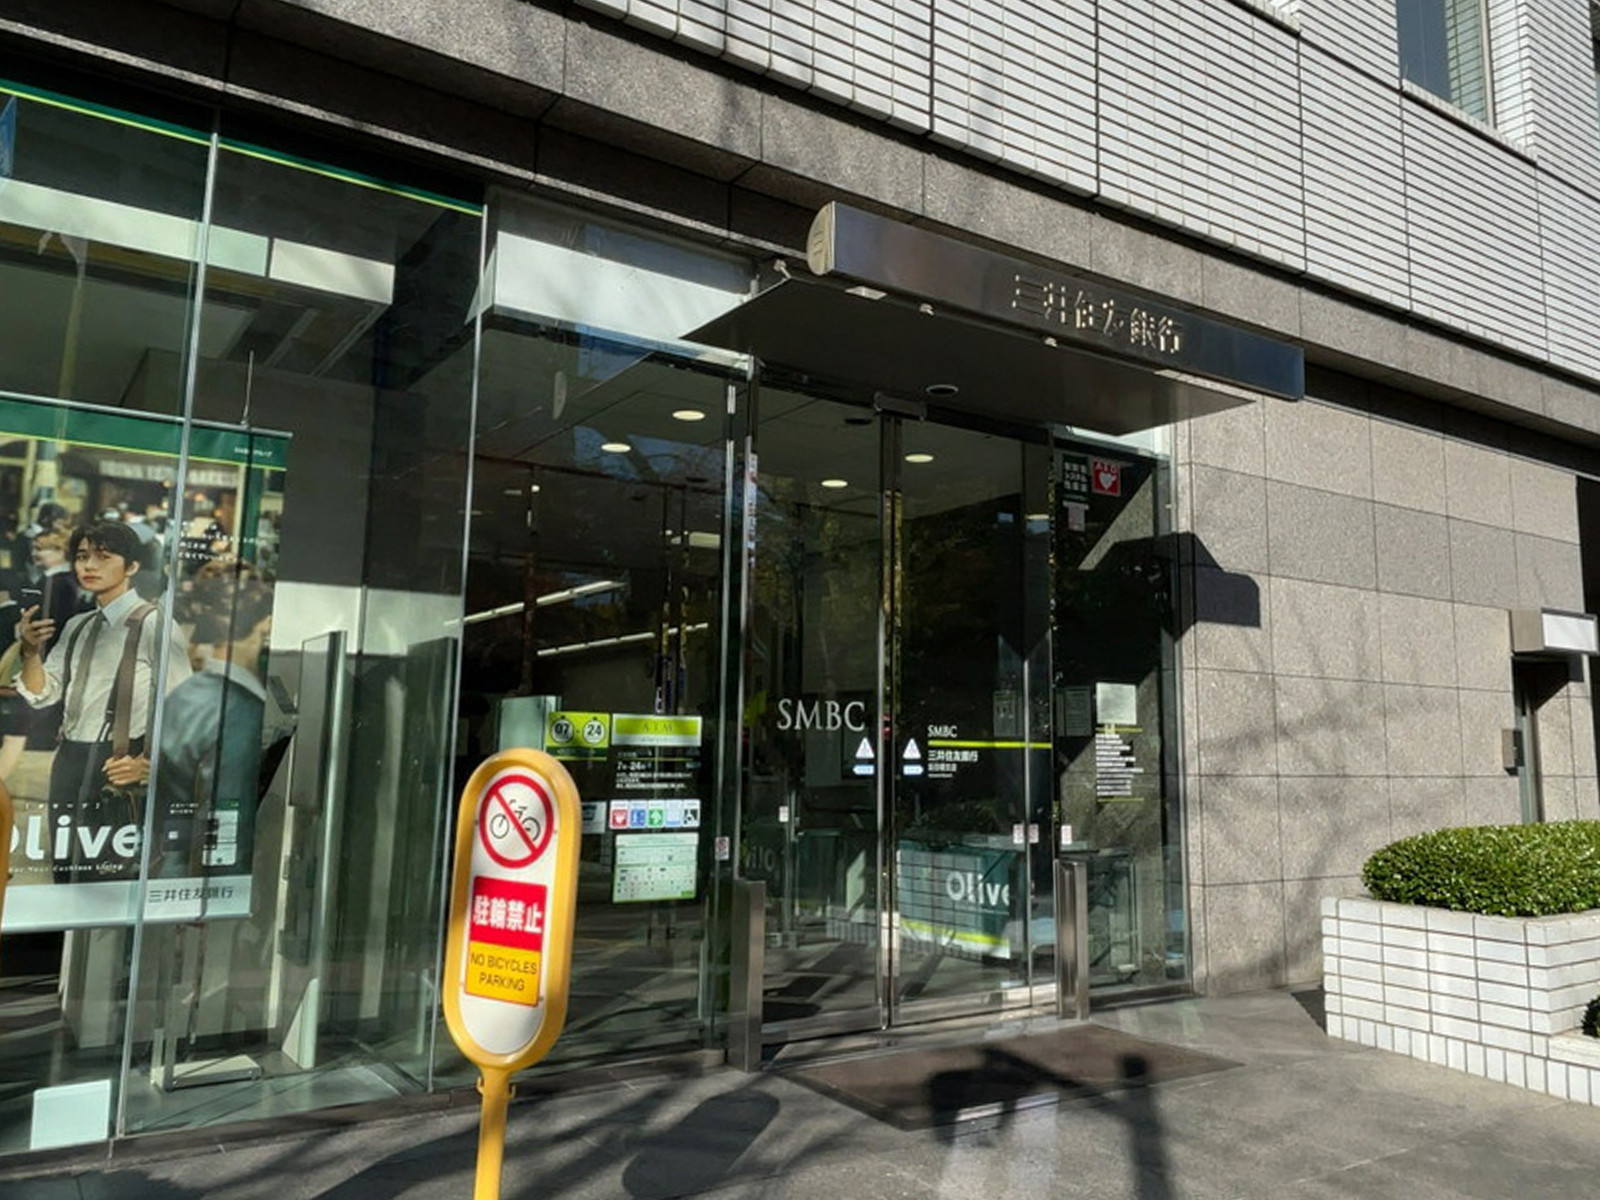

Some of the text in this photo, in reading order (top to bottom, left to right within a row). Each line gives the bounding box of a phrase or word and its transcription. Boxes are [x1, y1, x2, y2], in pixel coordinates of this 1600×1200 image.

[1011, 274, 1182, 353] 三井住友銀行
[777, 698, 865, 732] SMBC
[587, 724, 602, 736] 24
[928, 724, 958, 738] SMBC
[473, 894, 542, 934] 駐輪禁止
[470, 952, 538, 975] NO BICYCLES
[479, 971, 525, 991] PARKING
